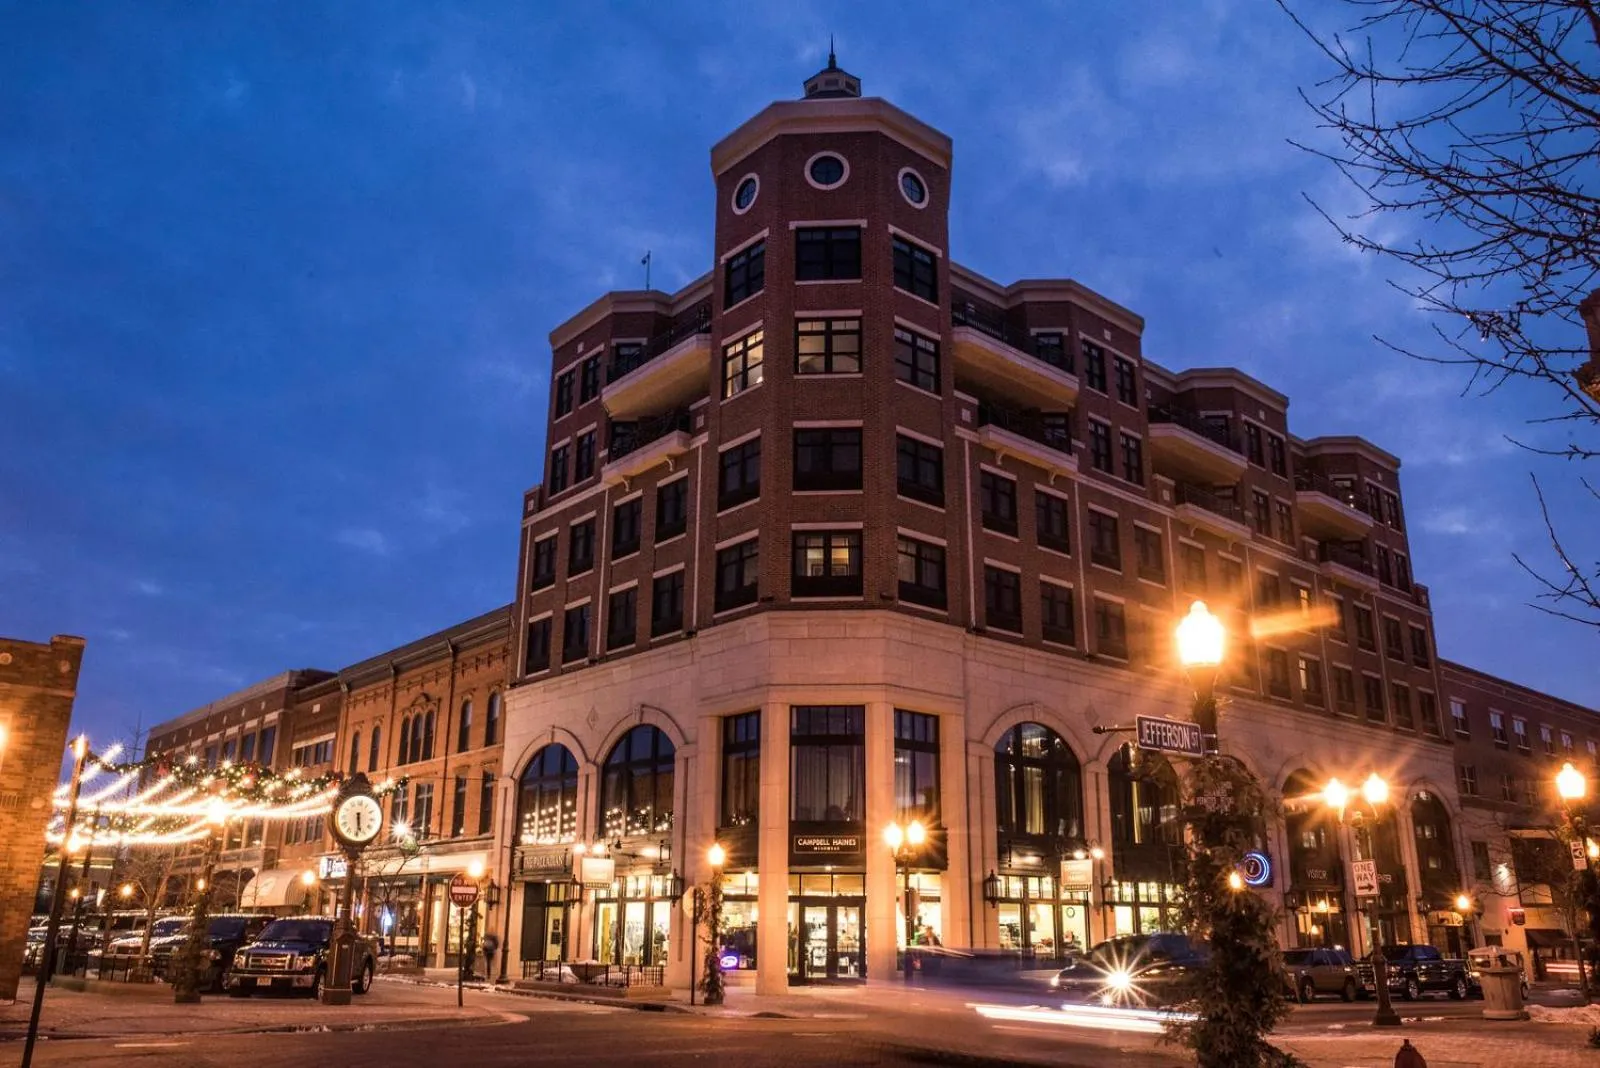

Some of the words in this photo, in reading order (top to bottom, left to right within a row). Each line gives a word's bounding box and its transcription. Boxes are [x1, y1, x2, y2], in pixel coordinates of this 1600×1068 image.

[1140, 720, 1190, 749] JEFFERSON
[1191, 731, 1199, 748] ST
[797, 838, 830, 846] CAMPBELL
[833, 838, 856, 846] HAINES
[1354, 863, 1373, 873] ONE
[1356, 872, 1375, 882] WAY
[454, 894, 474, 902] ENTER
